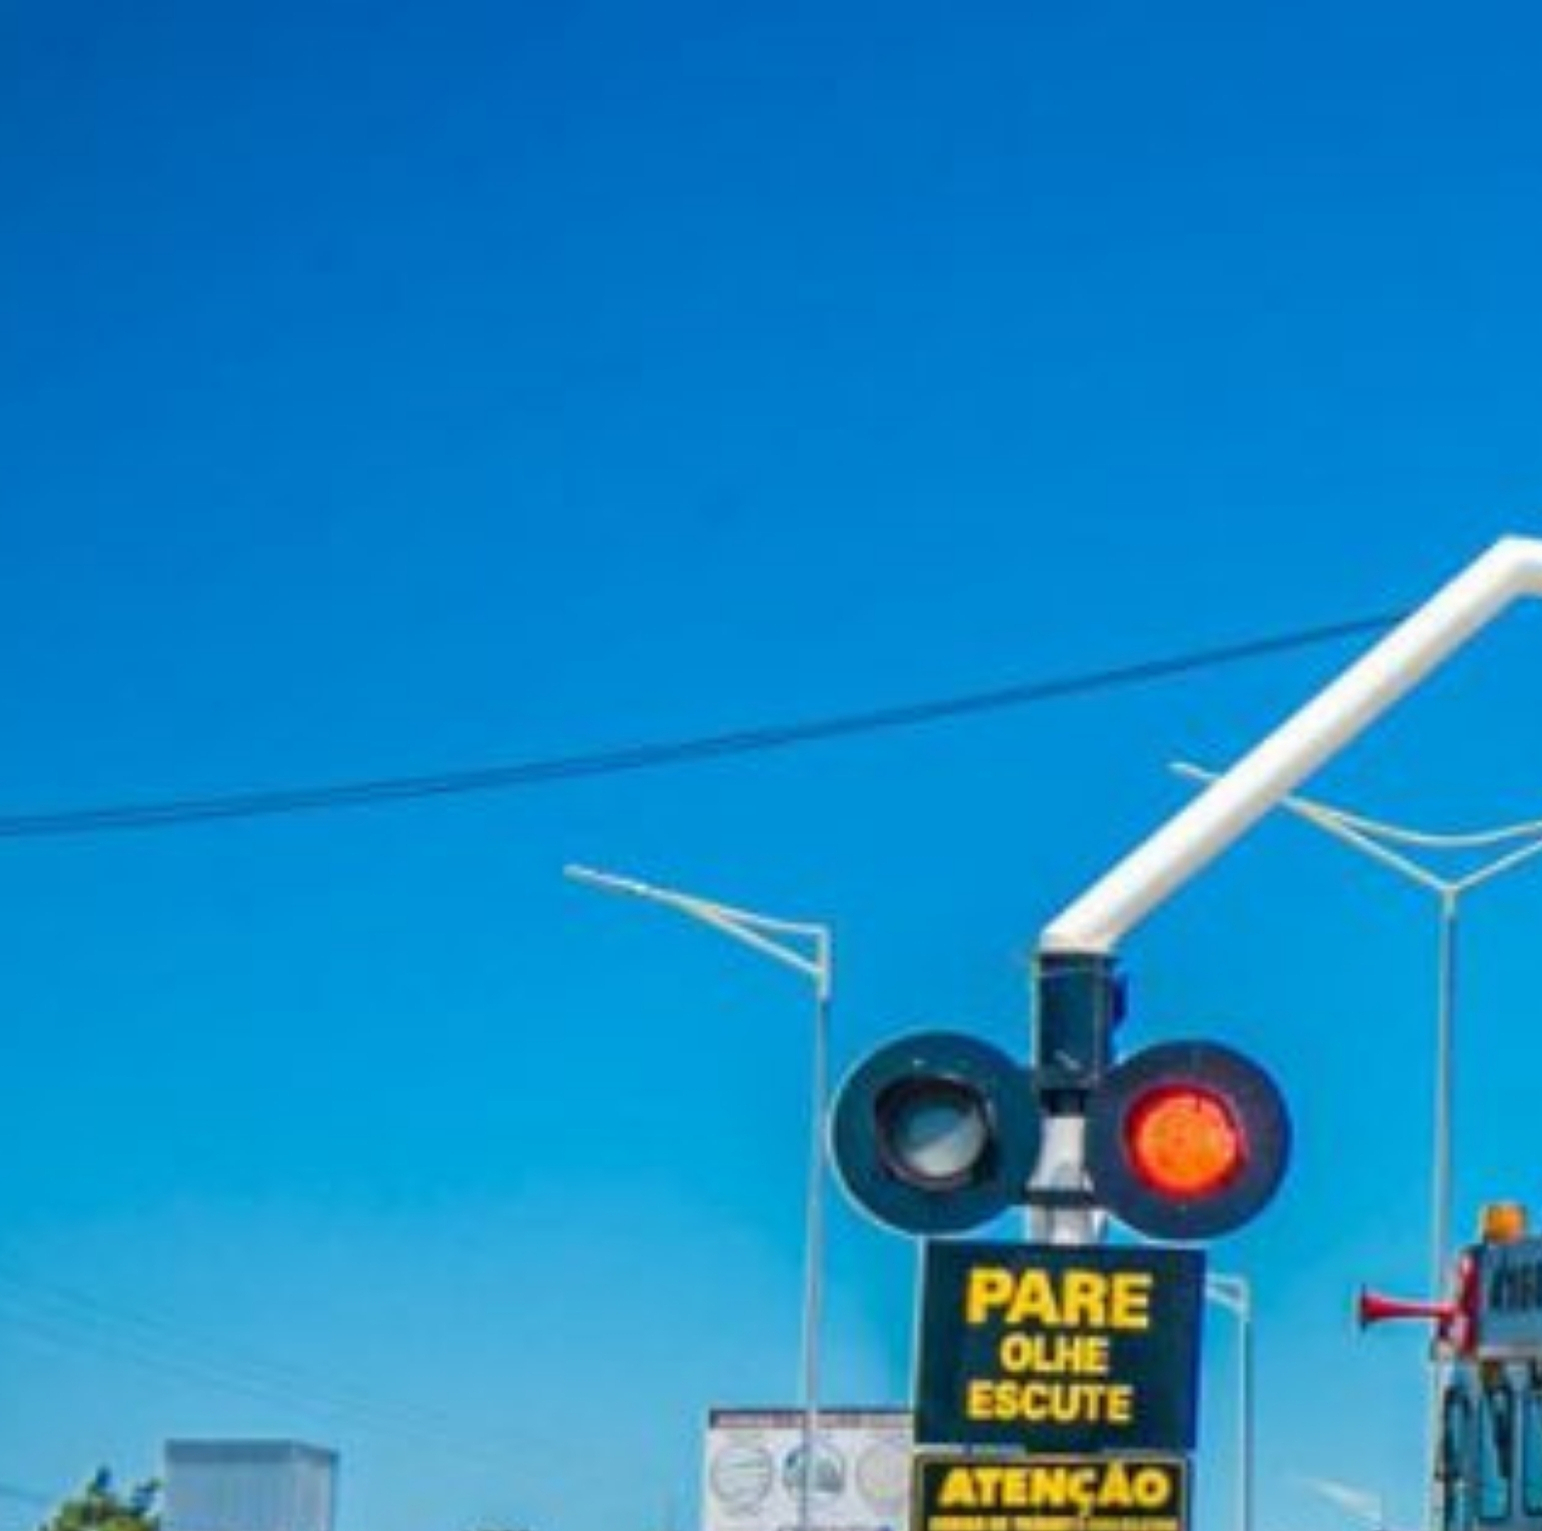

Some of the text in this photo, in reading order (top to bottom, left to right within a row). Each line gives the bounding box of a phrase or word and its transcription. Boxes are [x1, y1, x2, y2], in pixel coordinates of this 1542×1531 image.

[965, 1266, 1152, 1329] PARE
[1000, 1334, 1110, 1373] OLHE
[967, 1380, 1132, 1423] ESCUTE
[938, 1459, 1170, 1517] ATENÇÃO
